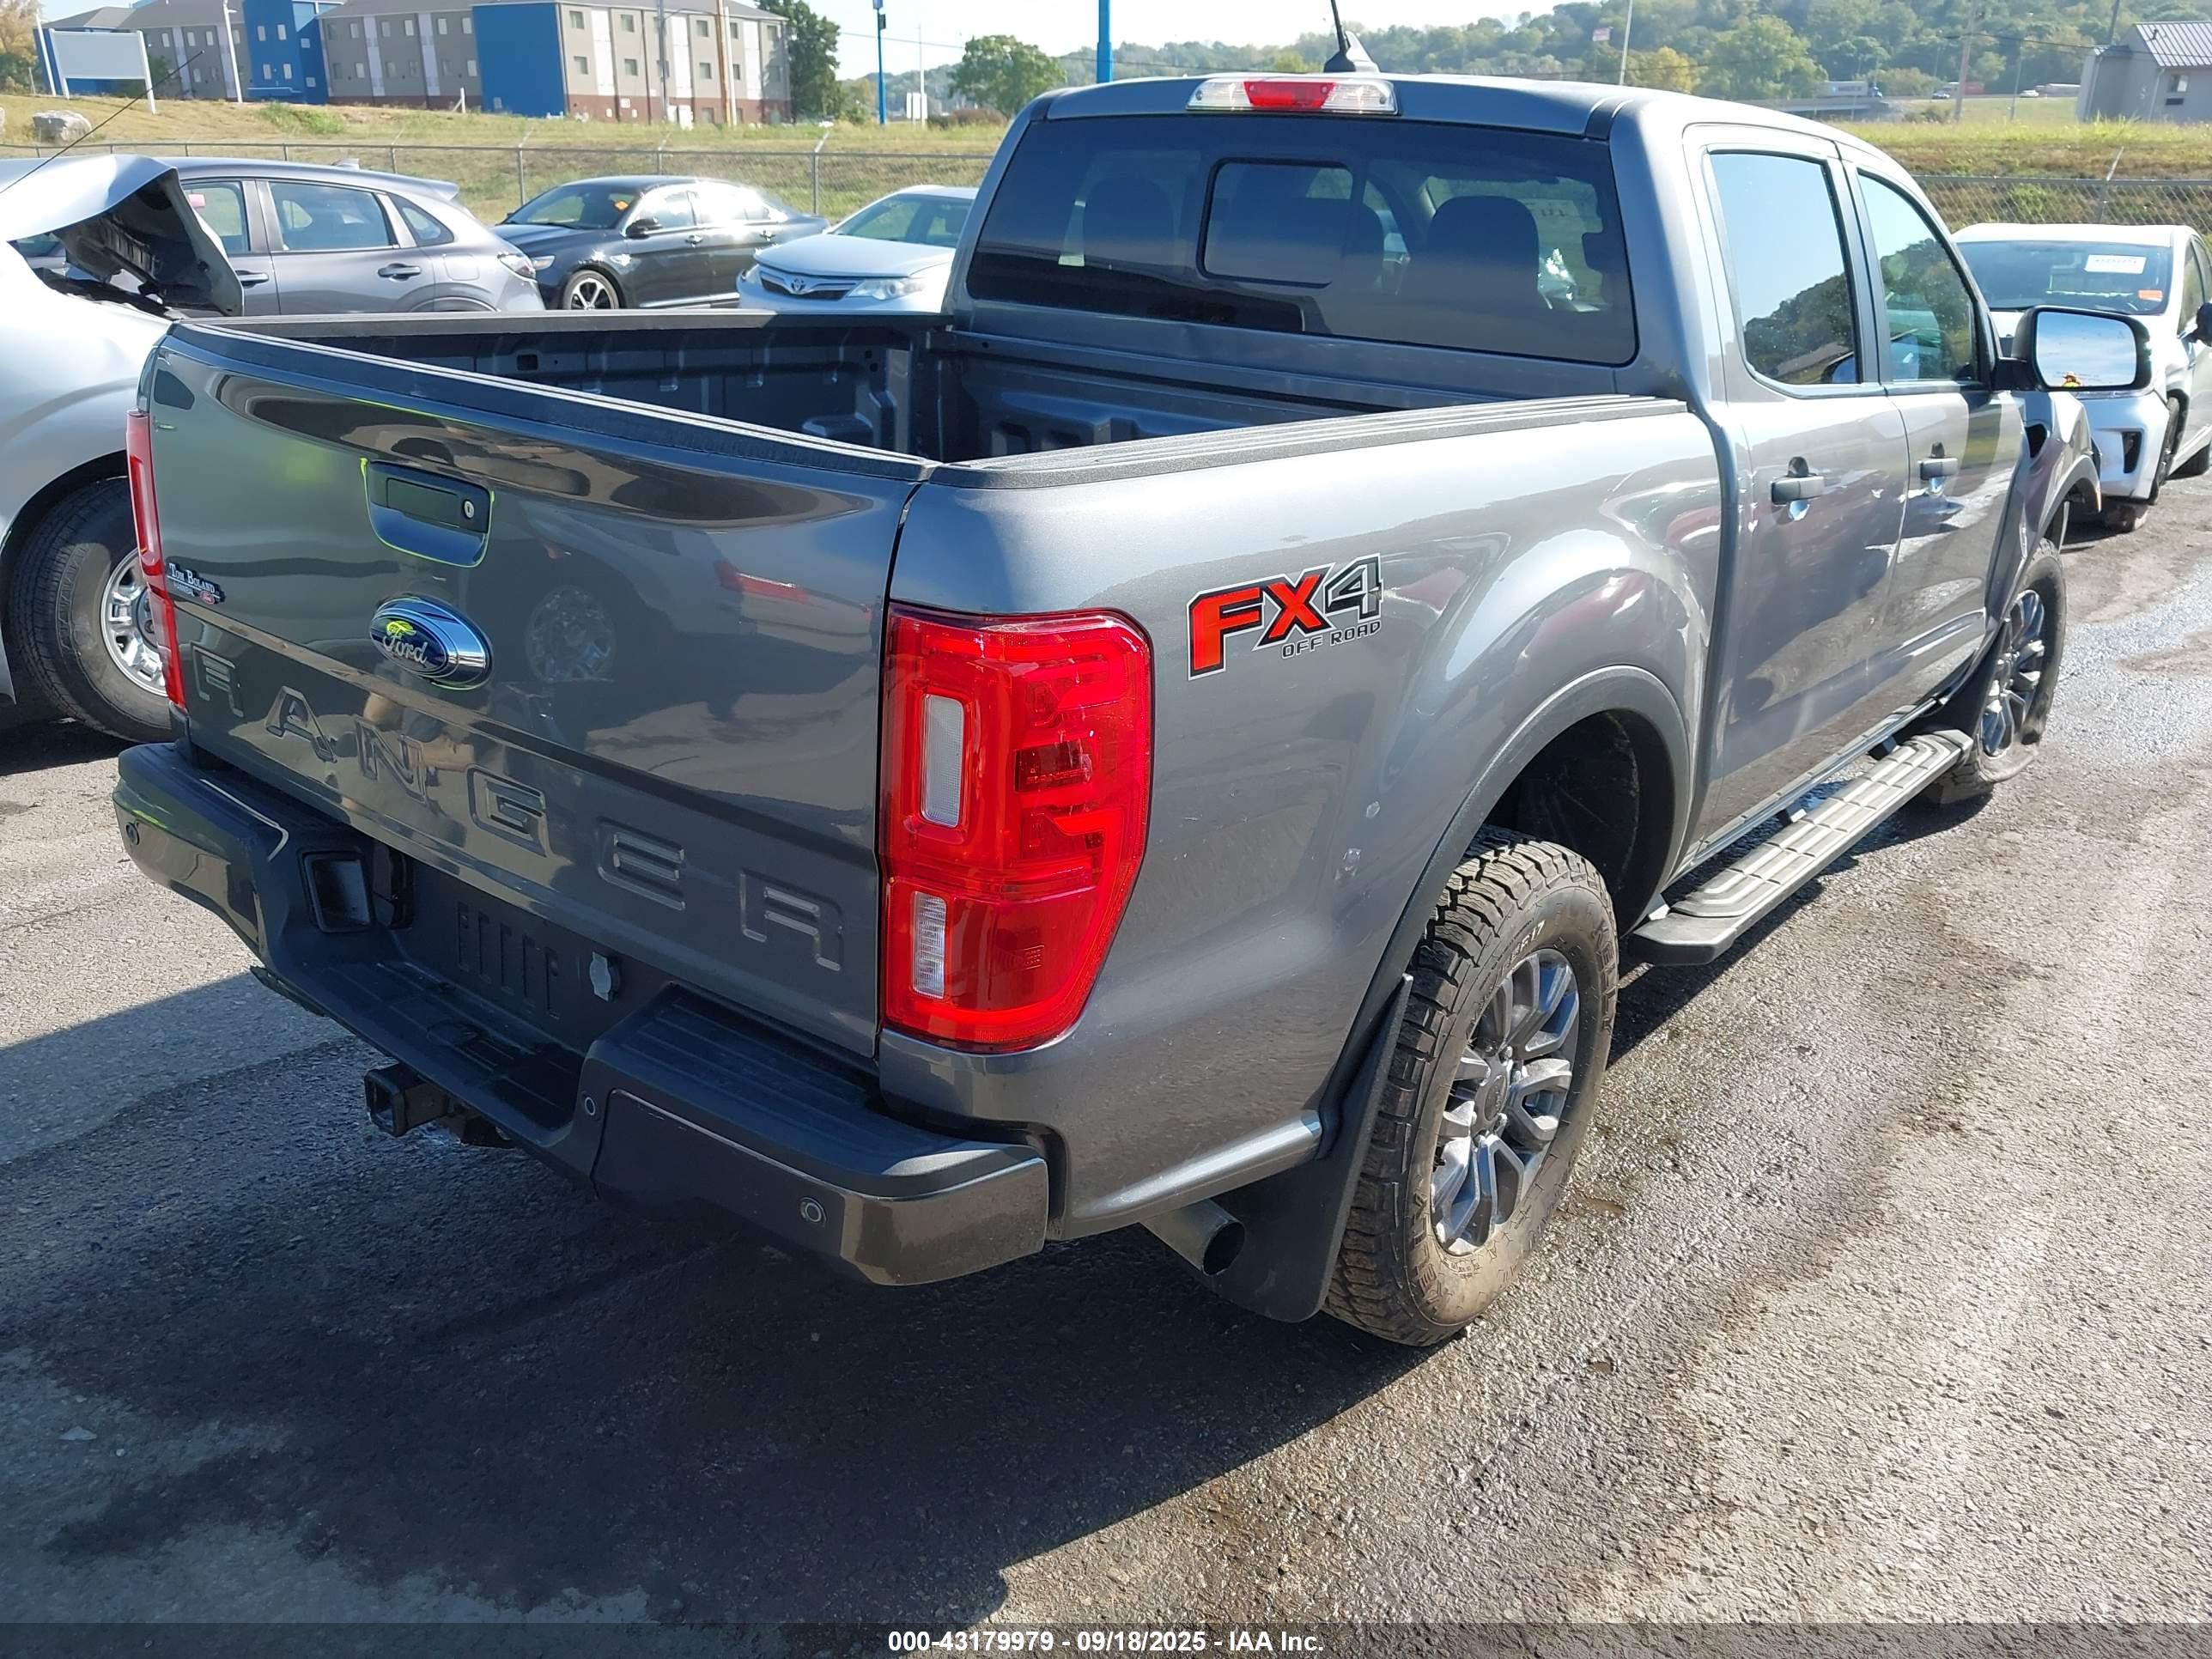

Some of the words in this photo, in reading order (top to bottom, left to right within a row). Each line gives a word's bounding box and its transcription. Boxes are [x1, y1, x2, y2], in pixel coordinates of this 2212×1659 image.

[382, 620, 428, 665] Ford
[1187, 553, 1383, 680] FX4
[1282, 635, 1323, 659] OFF
[1330, 620, 1382, 647] ROAD
[190, 642, 845, 973] RANGER
